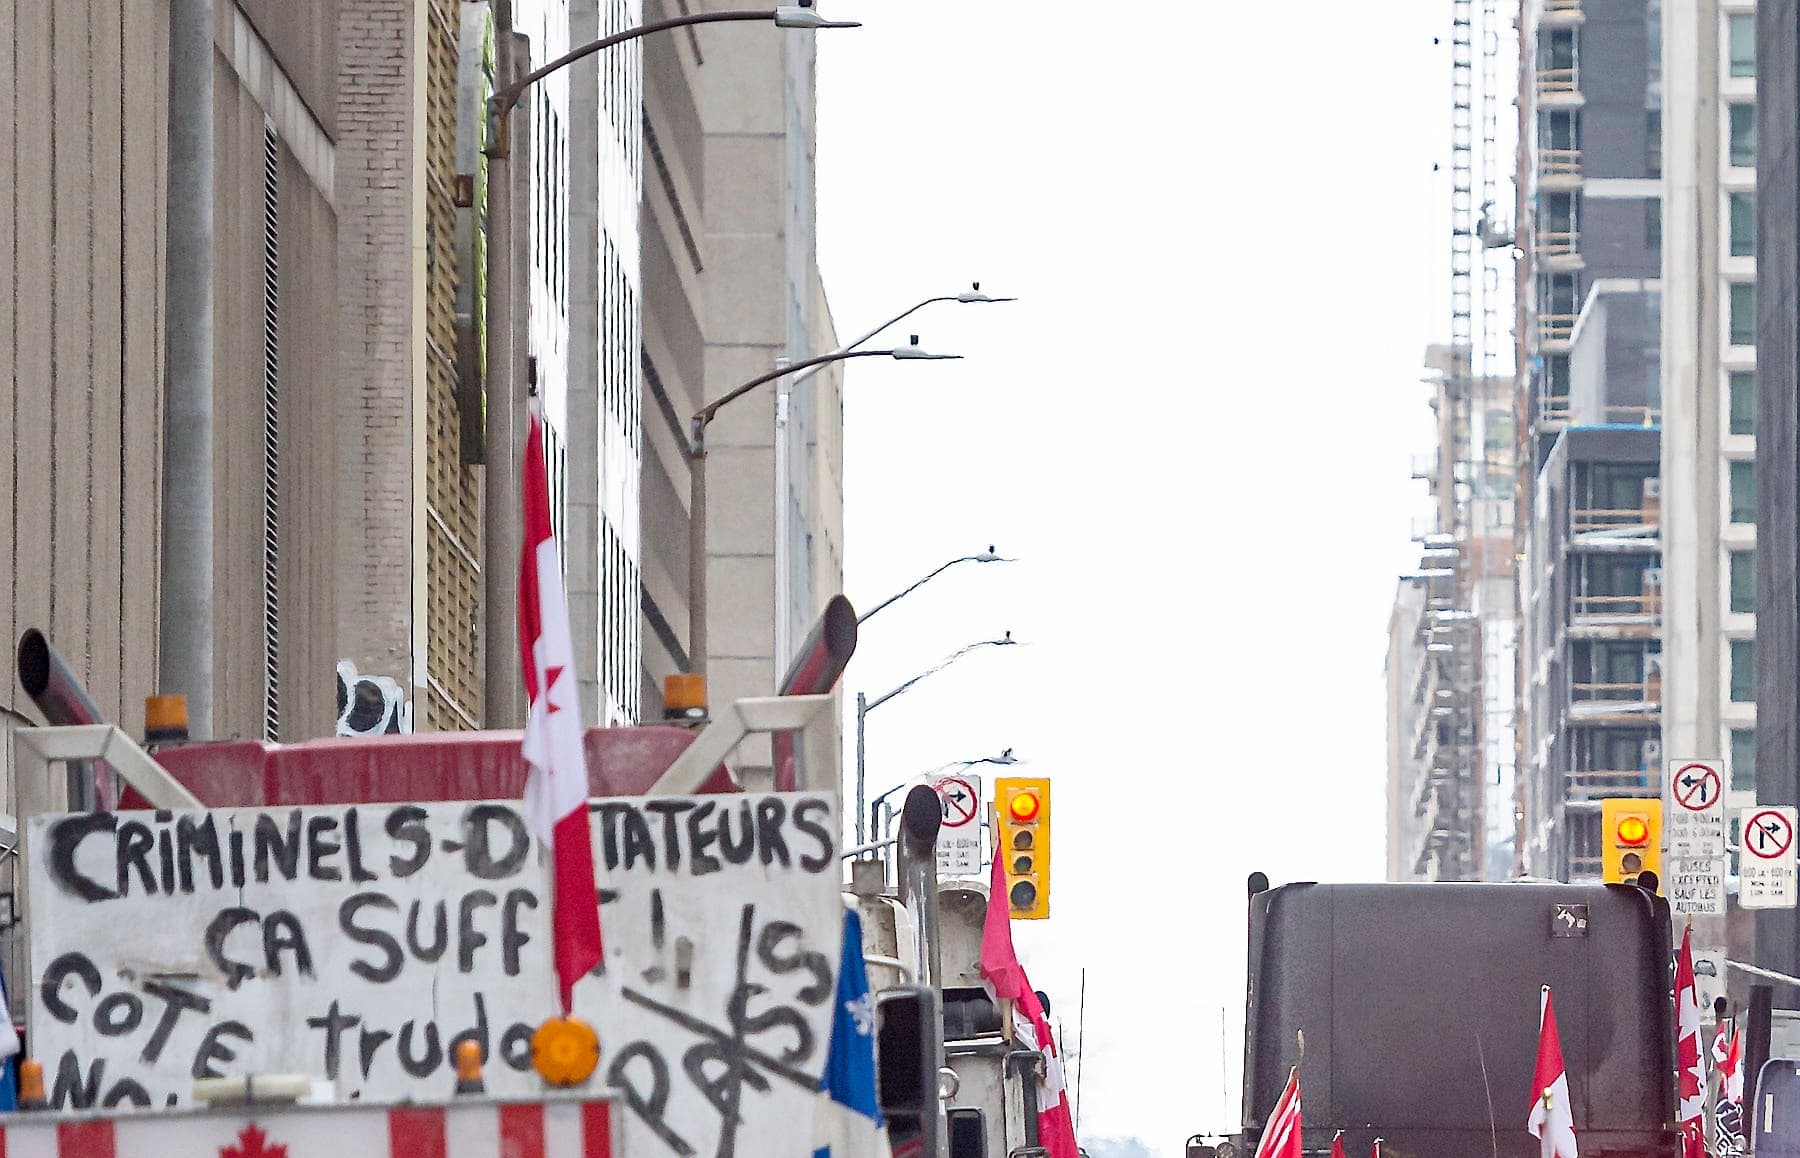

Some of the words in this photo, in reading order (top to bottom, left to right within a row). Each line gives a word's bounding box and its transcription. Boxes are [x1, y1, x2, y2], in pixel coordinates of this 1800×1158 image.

[1671, 875, 1719, 886] EXCEPTED
[1674, 888, 1697, 899] SAUF
[1676, 901, 1716, 913] AUTOBUS
[205, 904, 314, 991] ÇA
